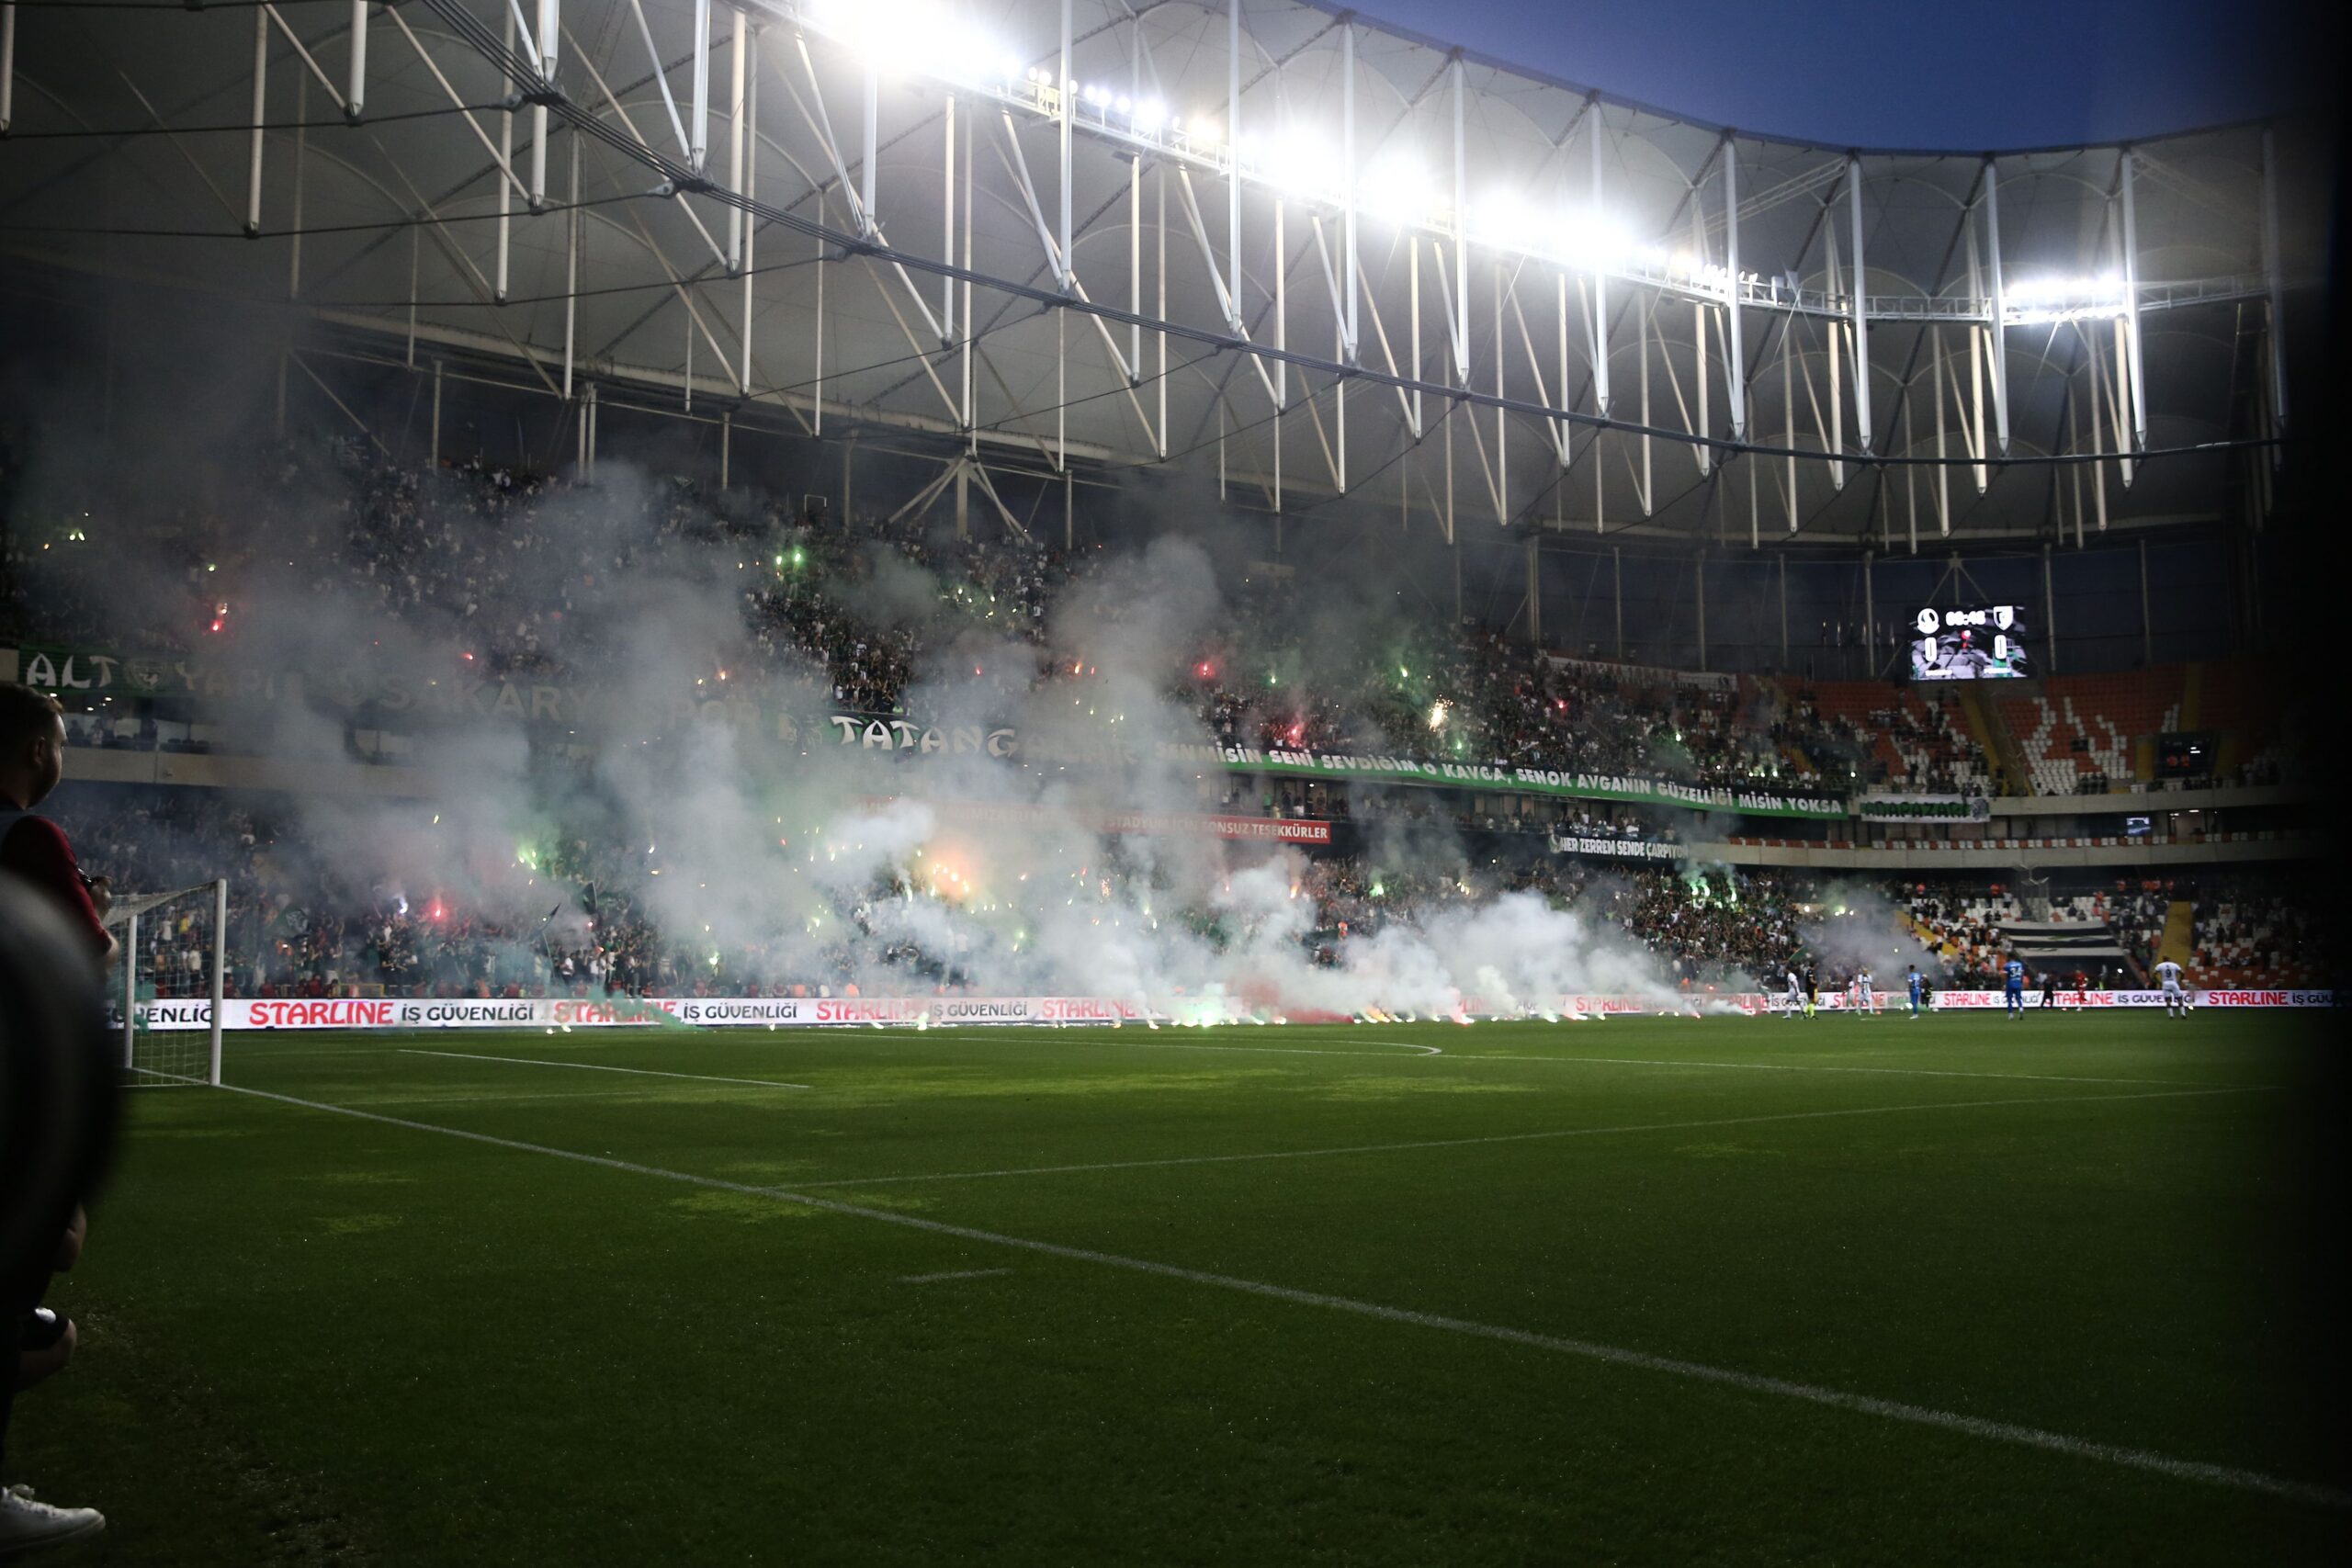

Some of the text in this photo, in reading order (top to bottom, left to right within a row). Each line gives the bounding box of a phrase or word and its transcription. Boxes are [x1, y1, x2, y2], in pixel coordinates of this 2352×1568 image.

[1924, 637, 1938, 662] 0
[1993, 634, 2007, 660] 0
[28, 651, 120, 688] ALT
[1268, 749, 1317, 768] SENİ
[1424, 763, 1438, 776] O
[1656, 782, 1734, 807] GÜZELLİĞİ
[1737, 791, 1783, 811] MİSİN
[1786, 796, 1843, 815] YOKSA
[1109, 815, 1169, 831] STADYUM
[1561, 836, 1579, 852] HER
[1578, 837, 1616, 854] ZERREM
[1616, 840, 1645, 856] SENDE
[2009, 967, 2023, 978] 34
[1042, 998, 1136, 1019] STARLINE
[1943, 992, 1991, 1007] STARLINE
[2209, 991, 2289, 1006] STARLINE
[2292, 991, 2304, 1006] İŞ
[250, 1001, 535, 1025] STARLINE İŞ GÜVENLİĞİ
[684, 1002, 702, 1022] İŞ
[704, 1001, 798, 1020] GÜVENLİĞİ
[817, 999, 922, 1021] STARLIN
[947, 1000, 1028, 1017] GÜVENLİĞİ
